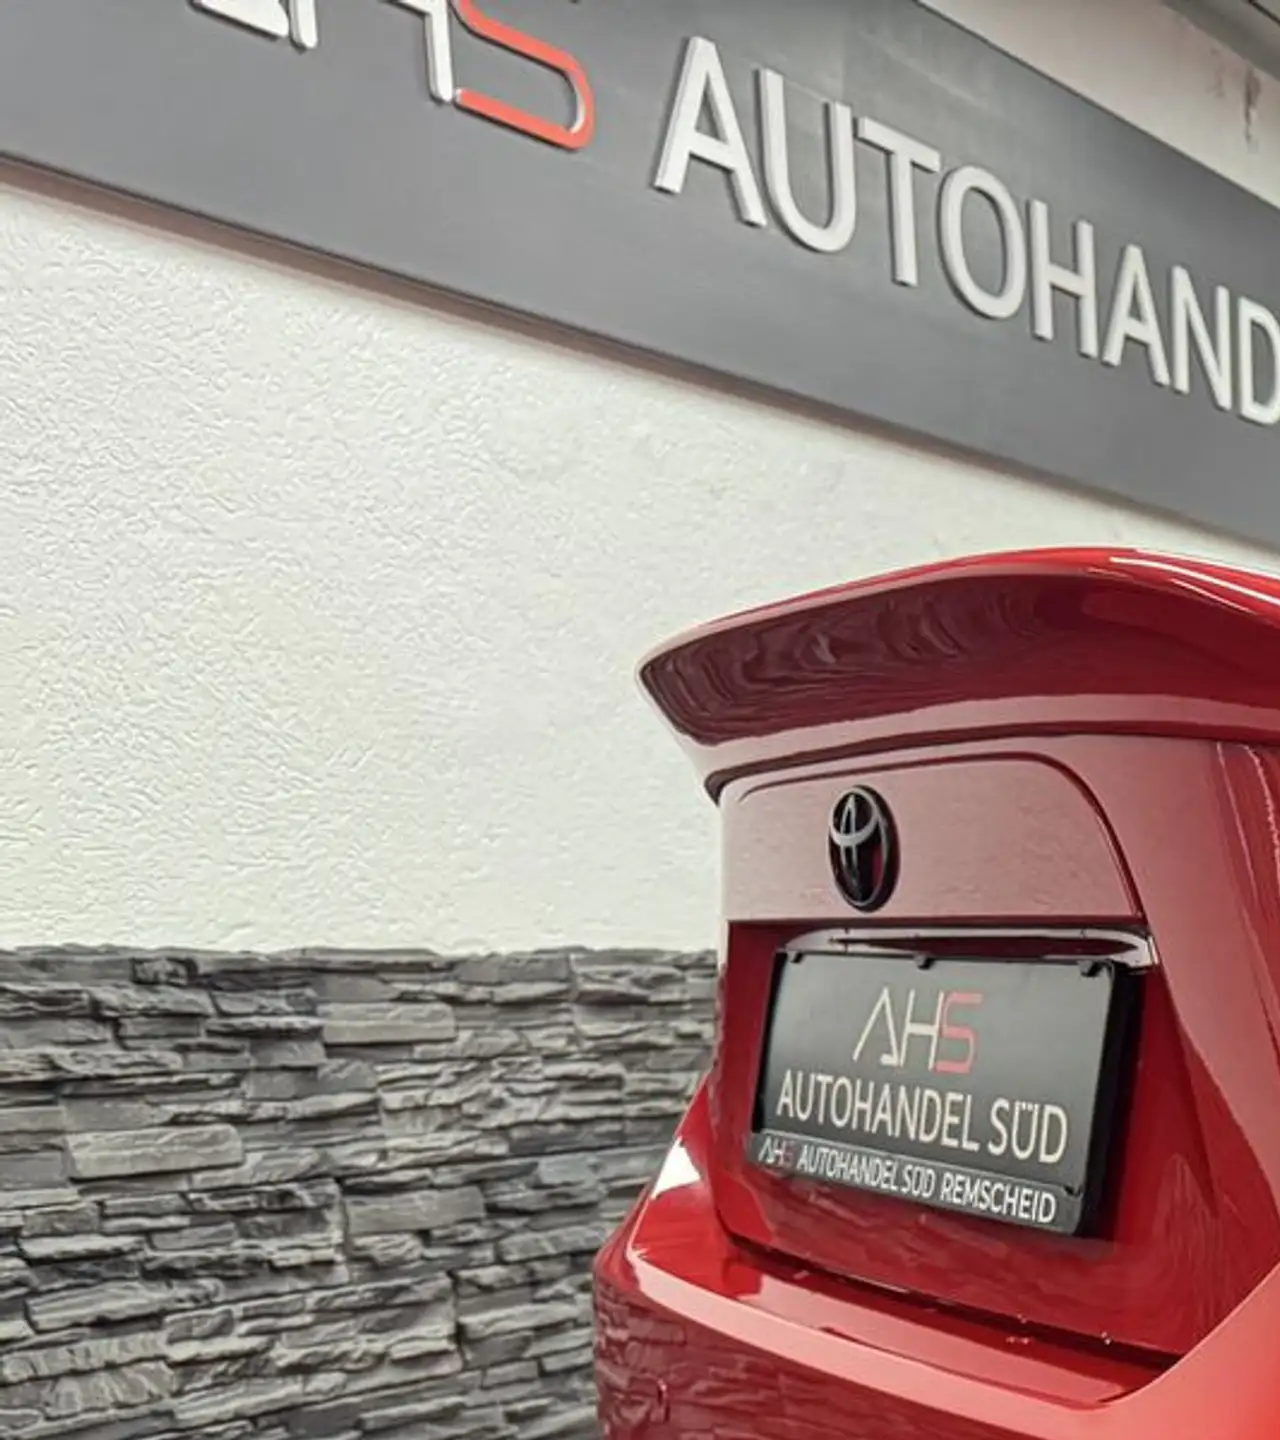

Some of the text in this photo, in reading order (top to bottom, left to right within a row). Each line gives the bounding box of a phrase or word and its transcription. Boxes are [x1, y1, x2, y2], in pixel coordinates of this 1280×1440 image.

[852, 987, 983, 1074] AHS
[776, 1069, 1068, 1163] AUTOHANDEL SÜD
[797, 1144, 899, 1191] AUTOHANDEL
[940, 1172, 1057, 1224] REMSCHEID
